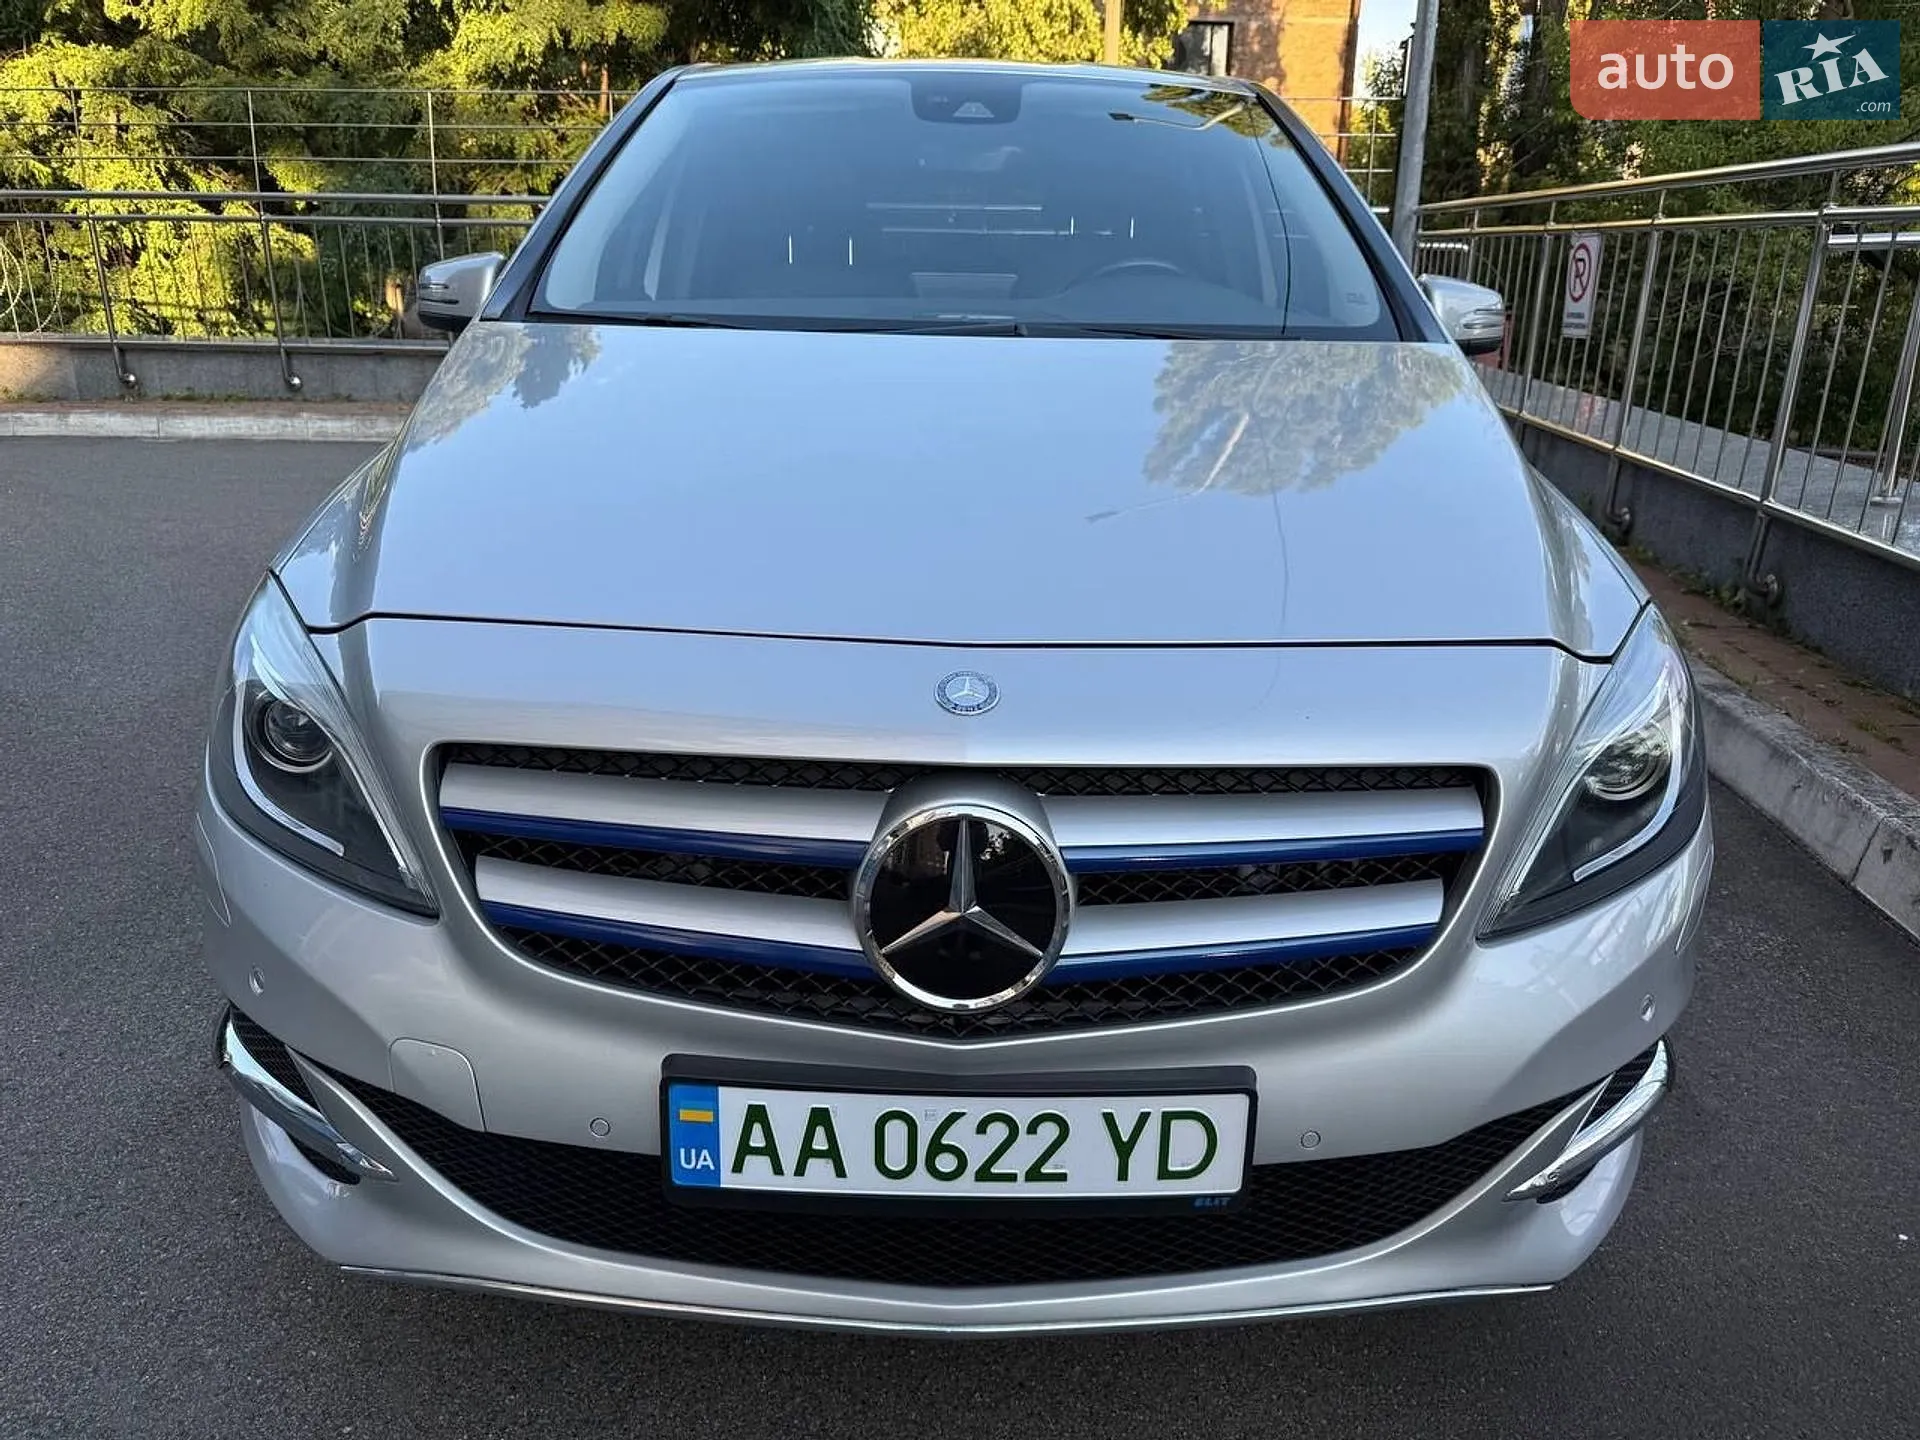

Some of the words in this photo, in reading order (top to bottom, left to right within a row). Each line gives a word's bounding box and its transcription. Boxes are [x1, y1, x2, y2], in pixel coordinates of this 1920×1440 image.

[680, 1148, 715, 1171] UA
[731, 1103, 848, 1179] AA
[874, 1109, 1069, 1182] 0622
[1101, 1109, 1218, 1182] YD
